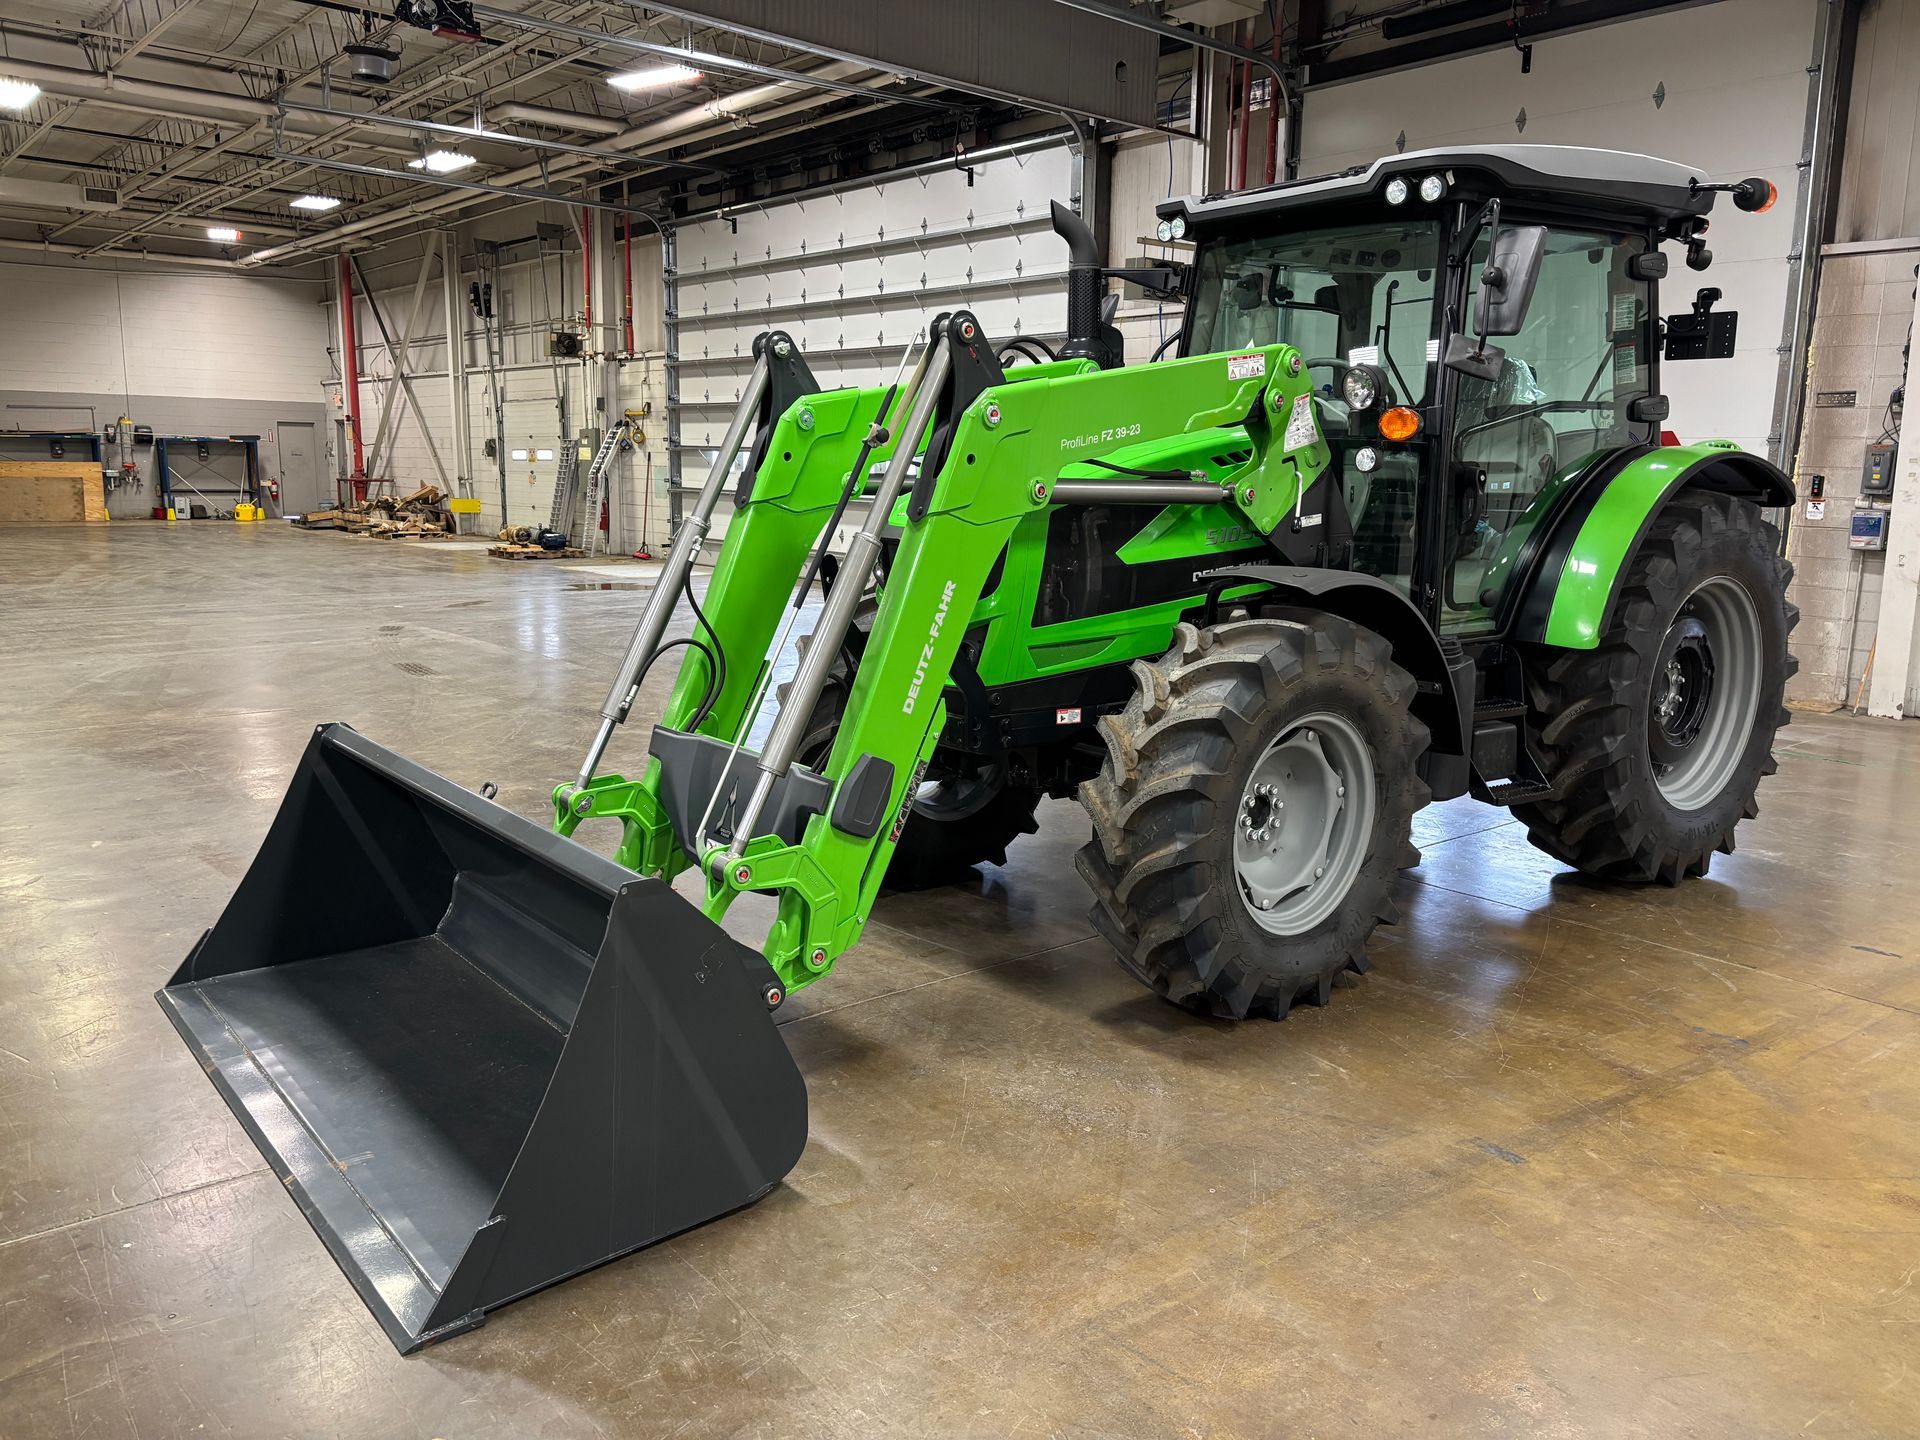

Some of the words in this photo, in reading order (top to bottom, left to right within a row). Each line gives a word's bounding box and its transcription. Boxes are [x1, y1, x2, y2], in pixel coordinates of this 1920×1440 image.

[1060, 434, 1099, 451] ProfiLine
[1101, 429, 1113, 442] FZ
[1115, 423, 1141, 439] 39-23
[902, 579, 957, 716] DEUTZ-FAHR
